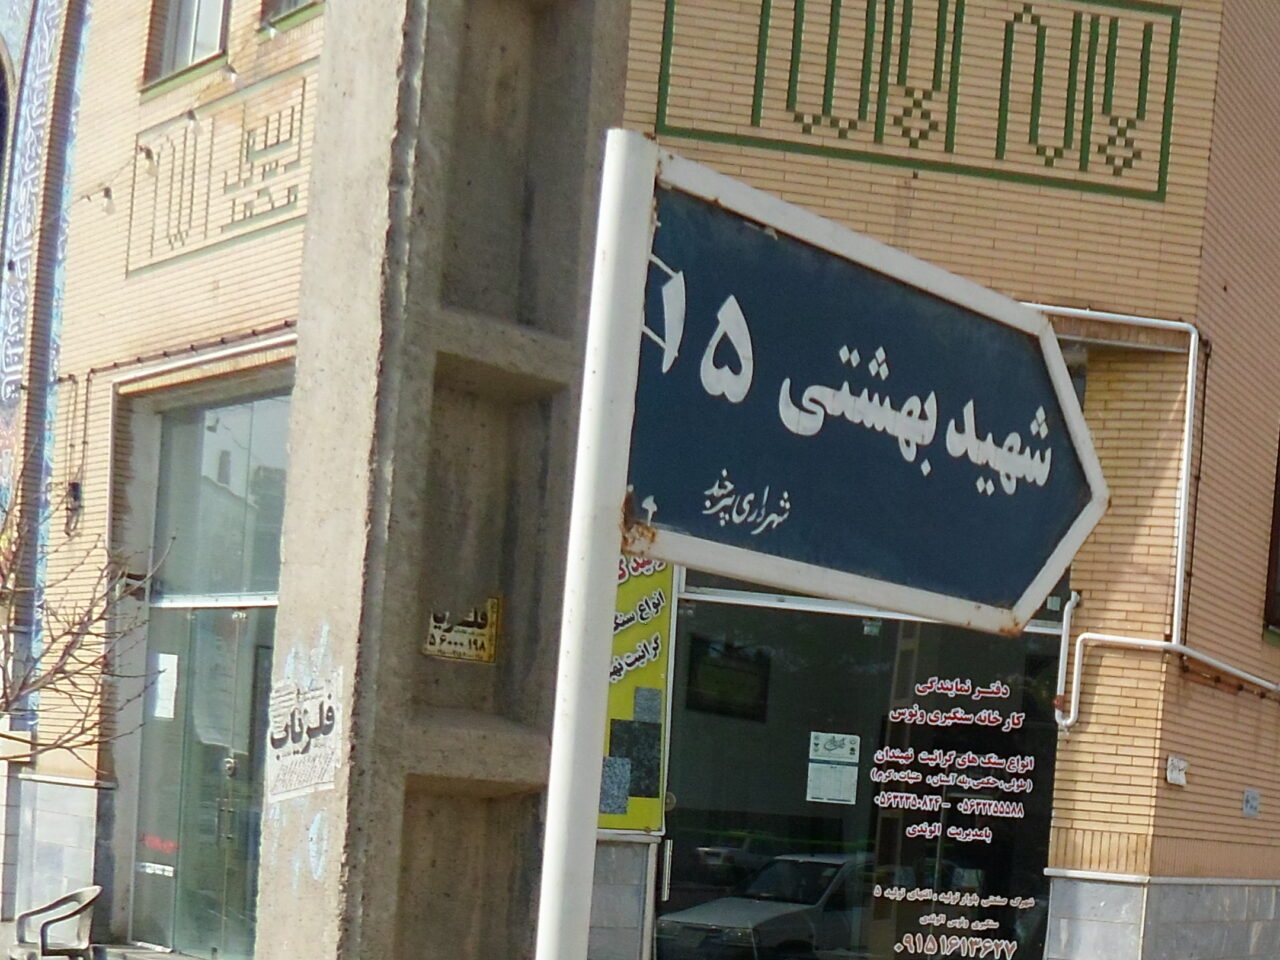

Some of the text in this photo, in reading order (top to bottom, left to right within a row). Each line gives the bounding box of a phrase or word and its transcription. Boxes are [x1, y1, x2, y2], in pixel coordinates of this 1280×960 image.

[779, 345, 938, 477] بهشتی
[946, 400, 1052, 496] شهید
[702, 468, 791, 535] شهرداری بیرجند
[637, 588, 667, 623] انواع
[624, 632, 661, 668] گرانیت
[915, 676, 1010, 700] دفتر نمایندگی
[889, 703, 926, 725] ونوس
[269, 693, 336, 761] فلزیاب
[874, 746, 914, 765] نهبندان
[918, 748, 956, 768] گرانیت
[955, 750, 980, 769] های
[980, 752, 1006, 770] سنگ
[1006, 754, 1035, 774] انواع
[906, 821, 942, 839] الوندی
[884, 886, 906, 901] تولید
[959, 892, 980, 907] بلوار
[980, 894, 1009, 908] صنعتی
[1010, 896, 1036, 909] شهرک
[918, 912, 947, 926] الوندی
[893, 932, 1018, 960] ۰۹۱۵۱۶۱۳۶۲۷
